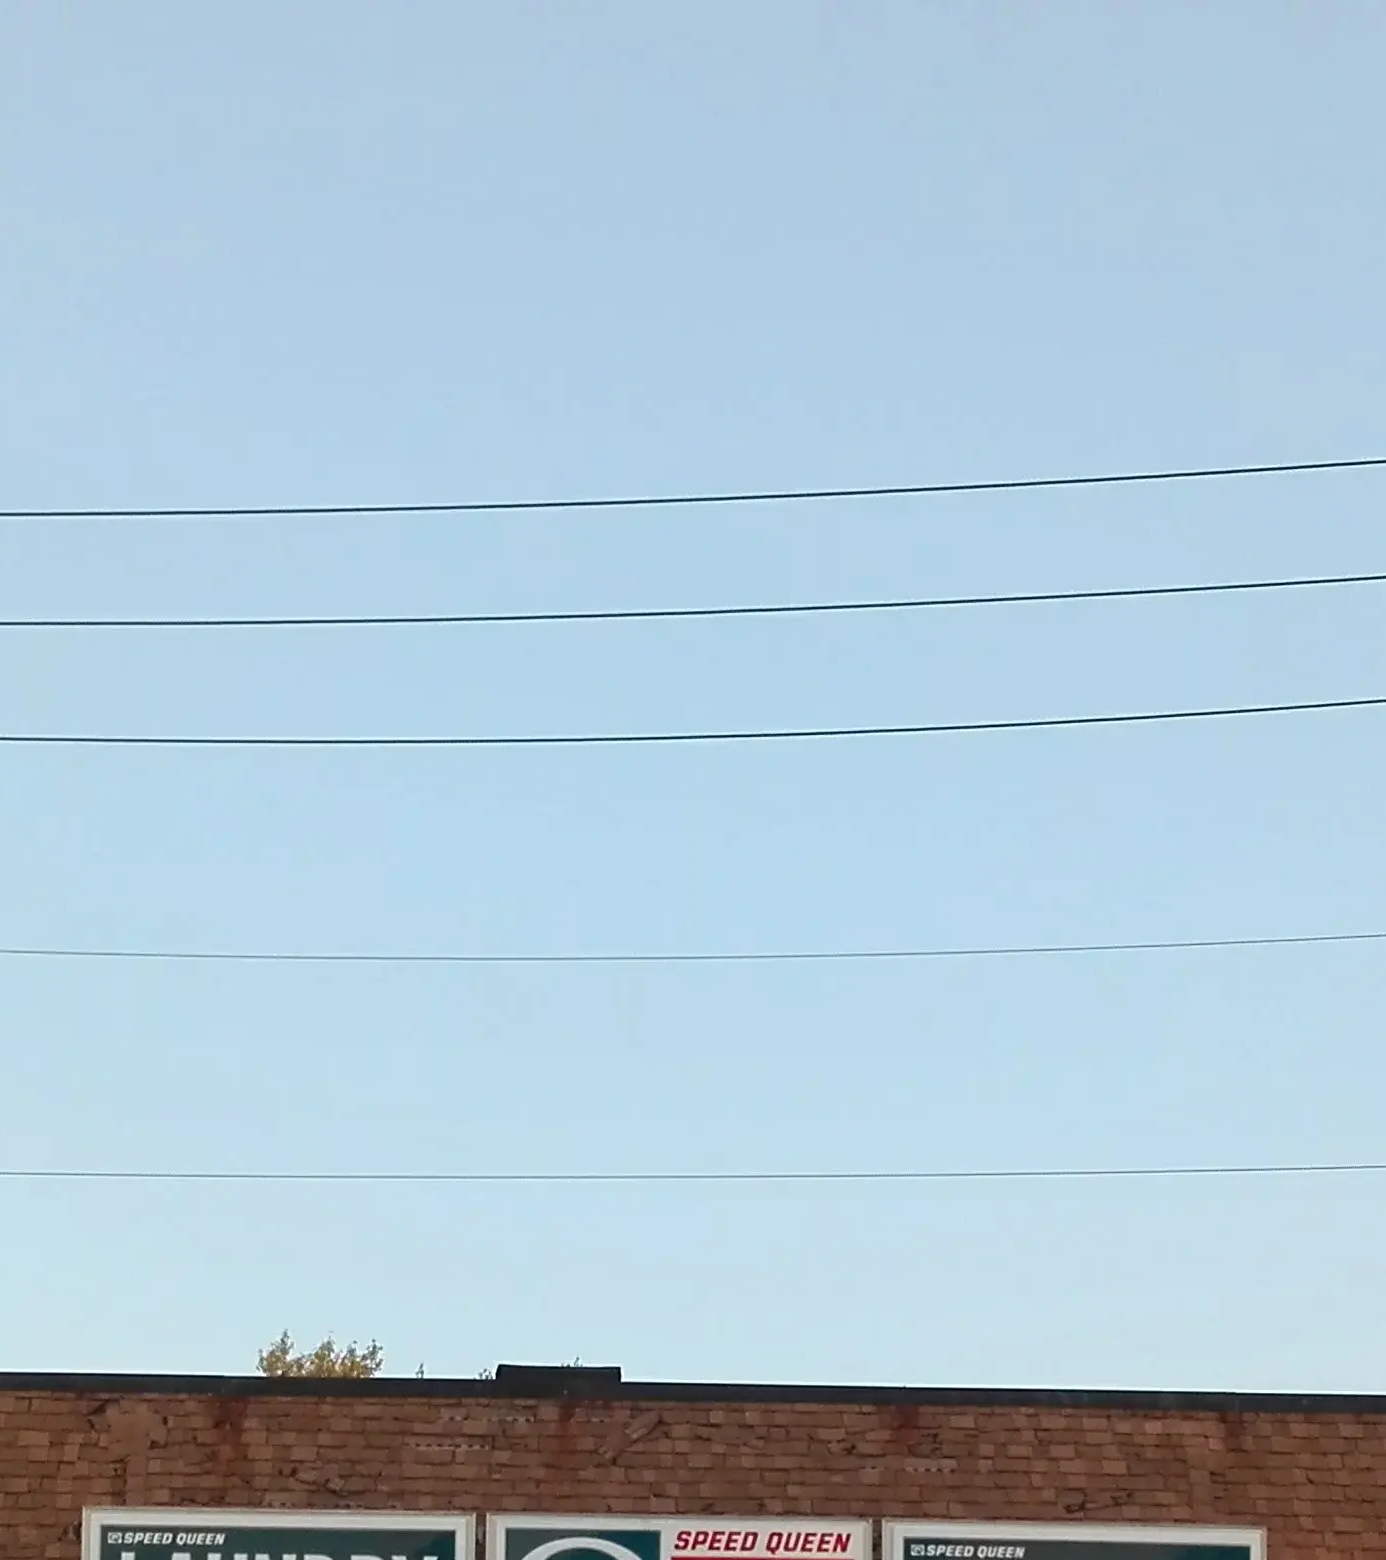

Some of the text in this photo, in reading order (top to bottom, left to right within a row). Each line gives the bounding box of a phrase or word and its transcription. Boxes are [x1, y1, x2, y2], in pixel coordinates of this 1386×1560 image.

[123, 1532, 226, 1546] SPEED QUEEN
[674, 1531, 851, 1554] SPEED QUEEN
[926, 1544, 1025, 1559] SPEED QUEEN
